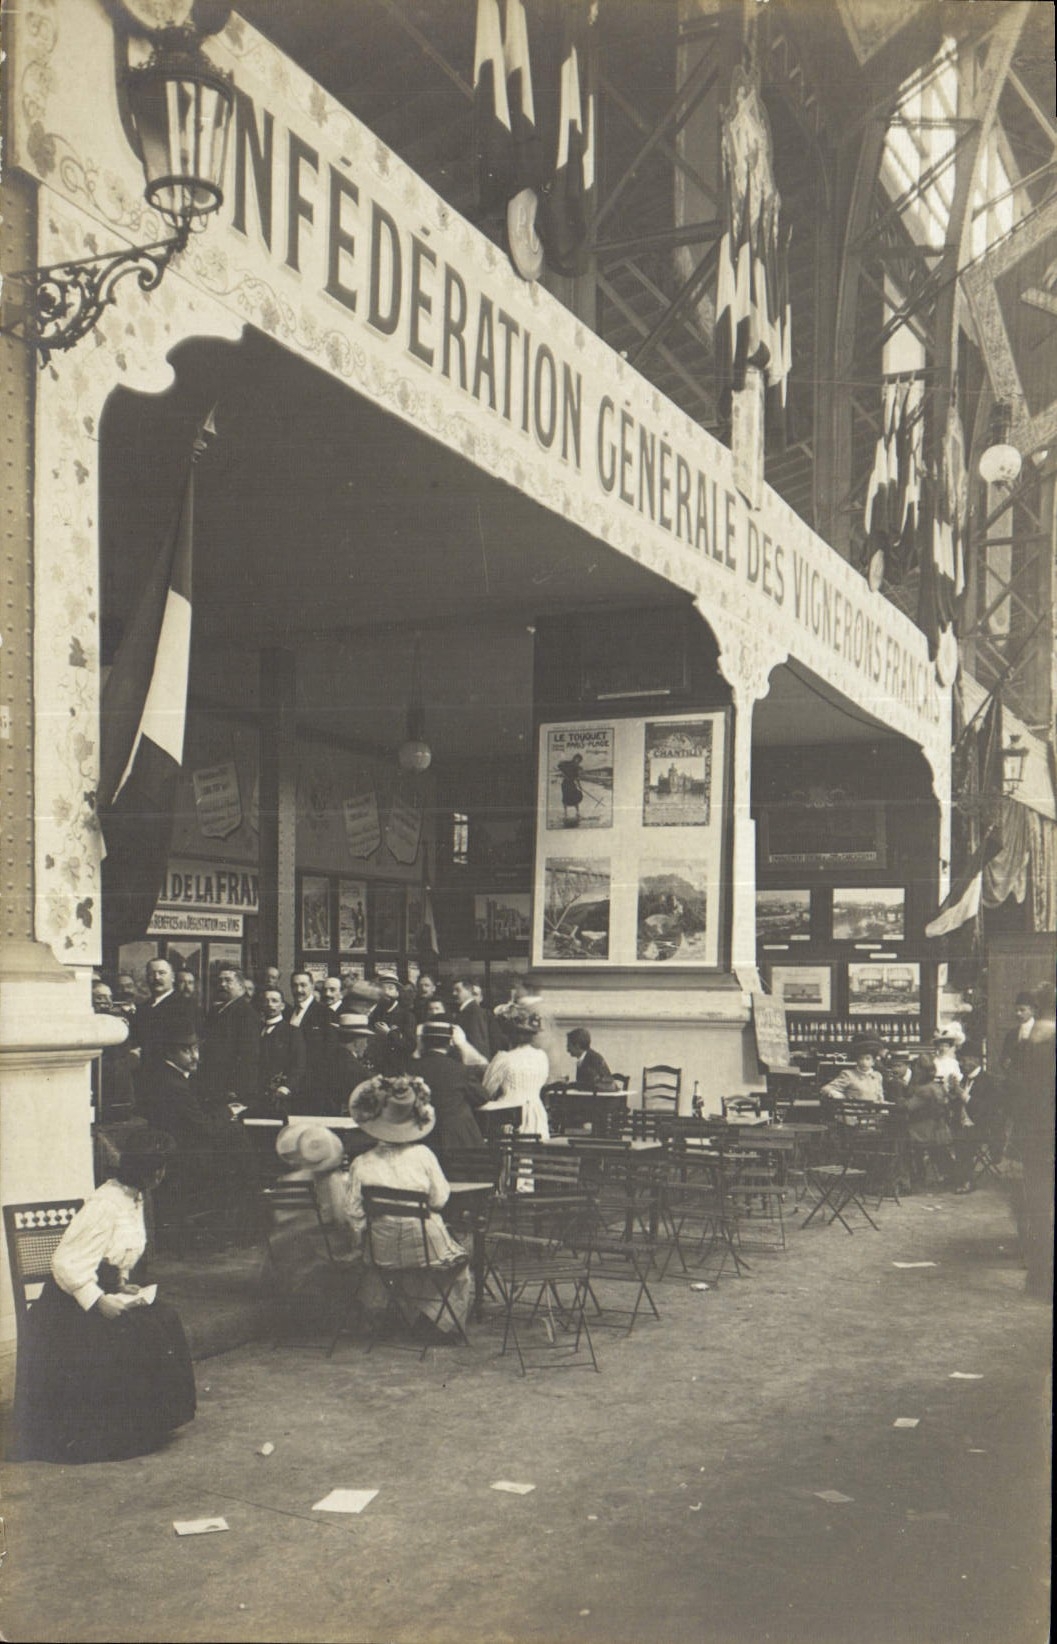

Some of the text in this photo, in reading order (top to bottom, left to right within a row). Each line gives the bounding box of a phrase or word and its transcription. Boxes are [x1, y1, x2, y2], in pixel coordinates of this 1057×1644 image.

[230, 83, 583, 471] NFÉDÉRATION
[746, 517, 785, 606] DES
[793, 550, 882, 683] VIGNERONS
[554, 731, 608, 742] LE TOUQUET
[653, 748, 703, 758] CHANTILLY
[171, 873, 193, 900] DE
[195, 875, 214, 903] LA
[215, 870, 259, 906] FRAN
